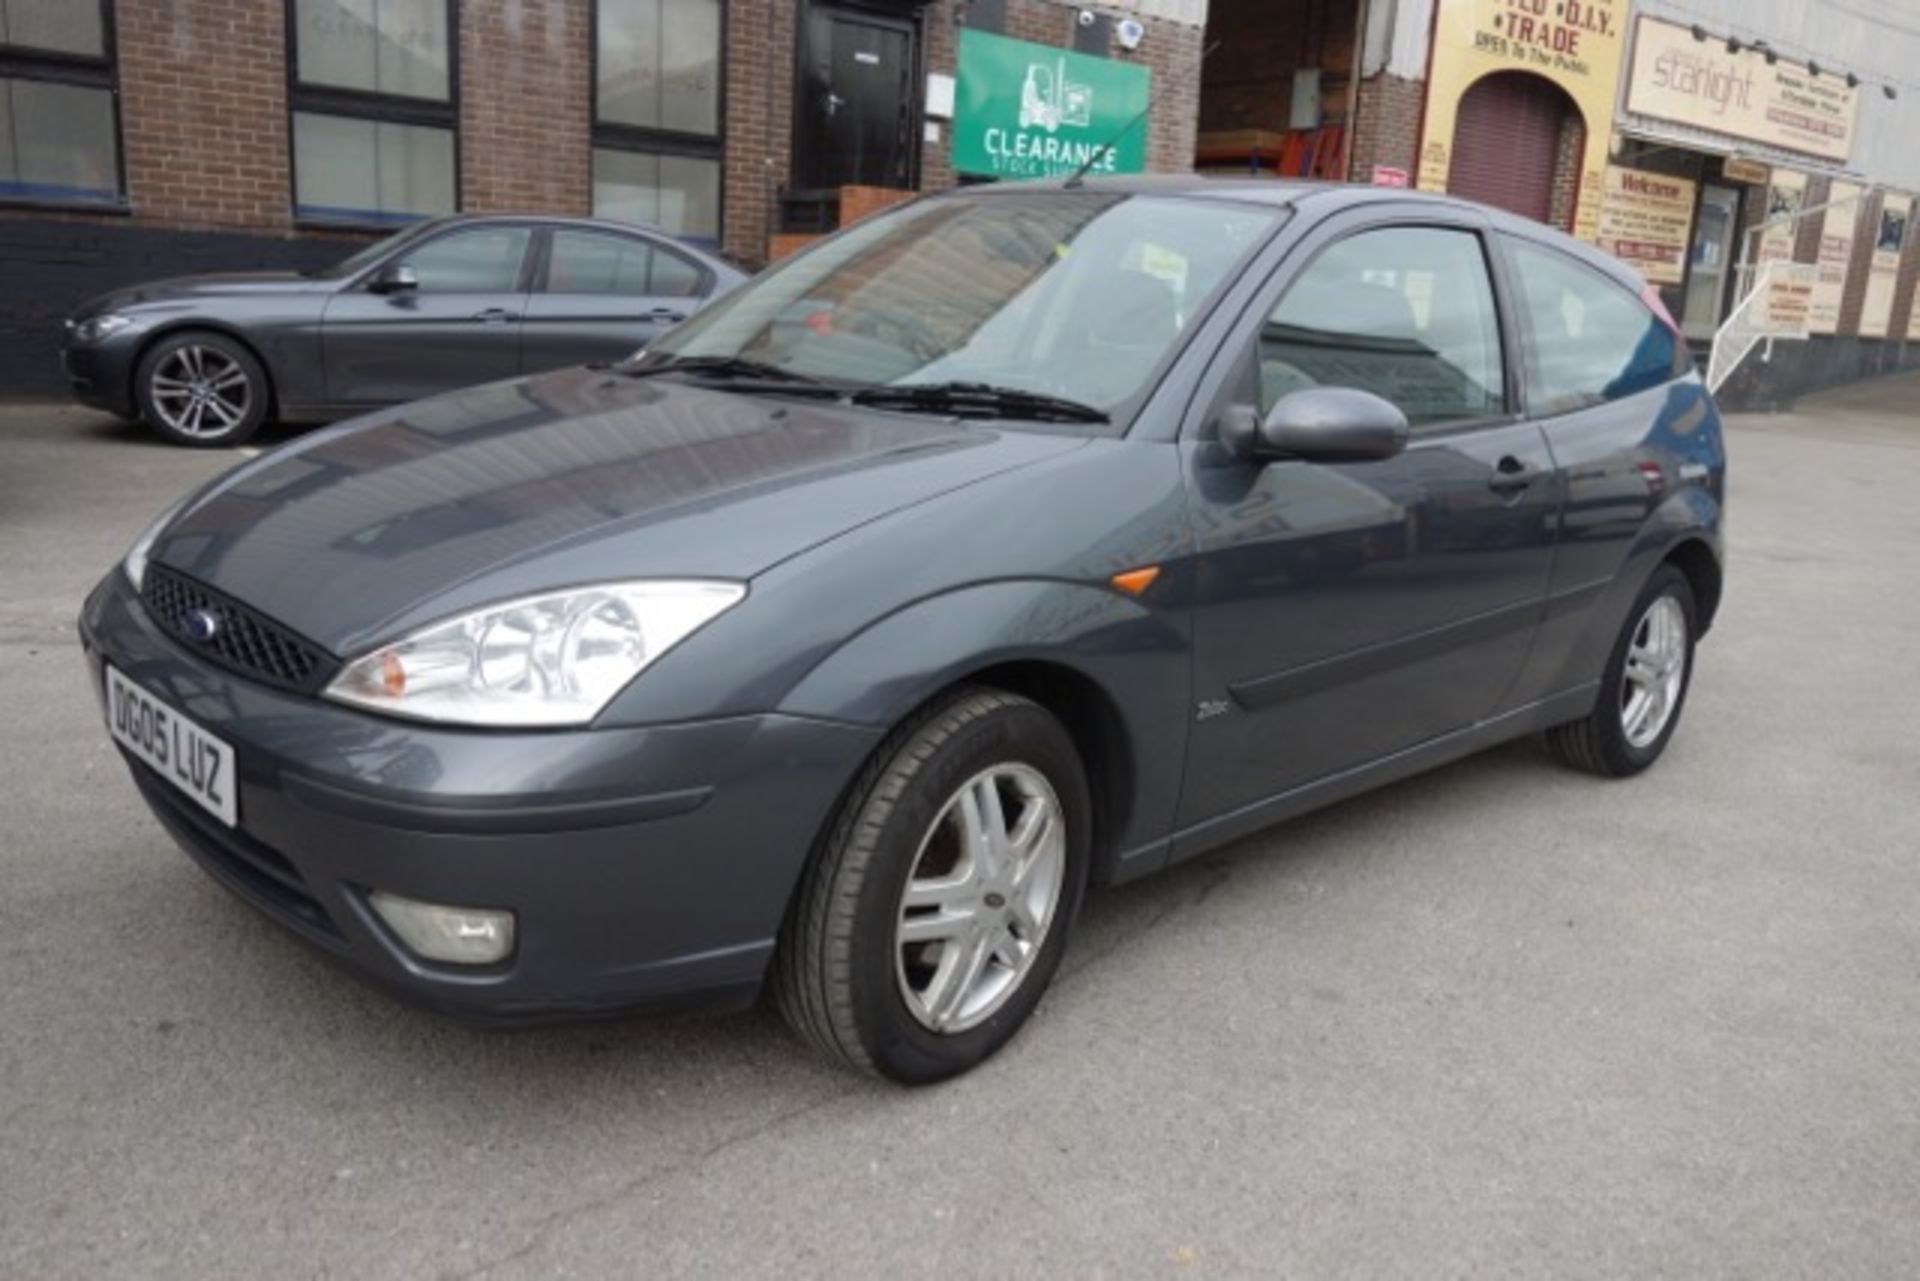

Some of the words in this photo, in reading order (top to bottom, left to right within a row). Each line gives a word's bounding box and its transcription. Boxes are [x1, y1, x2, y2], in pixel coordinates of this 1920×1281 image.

[1506, 12, 1580, 57] TRADE
[1652, 54, 1752, 116] starlight
[984, 128, 1118, 172] CLEARANCE
[114, 679, 169, 766] DG05
[174, 719, 224, 807] LUZ
